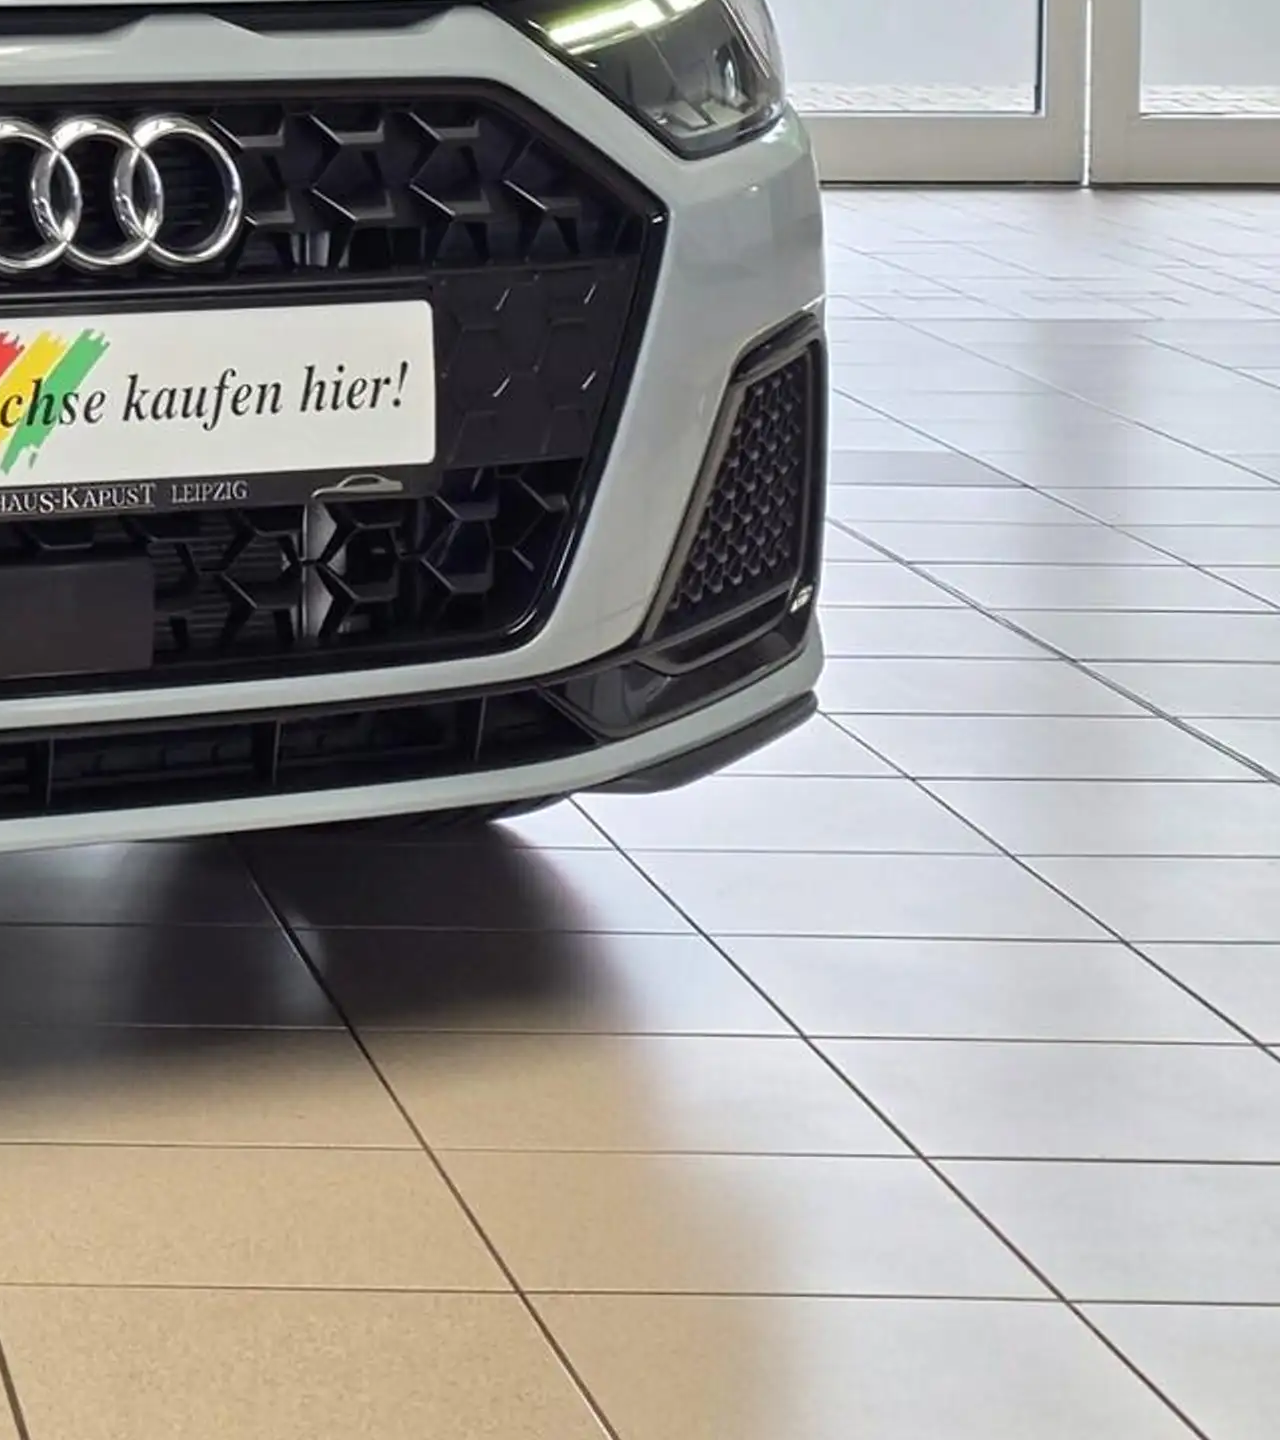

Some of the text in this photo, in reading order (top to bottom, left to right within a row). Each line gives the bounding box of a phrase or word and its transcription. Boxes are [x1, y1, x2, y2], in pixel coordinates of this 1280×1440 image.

[122, 368, 283, 432] kaufen
[299, 361, 410, 413] hier!
[171, 480, 248, 504] LEIPZIG
